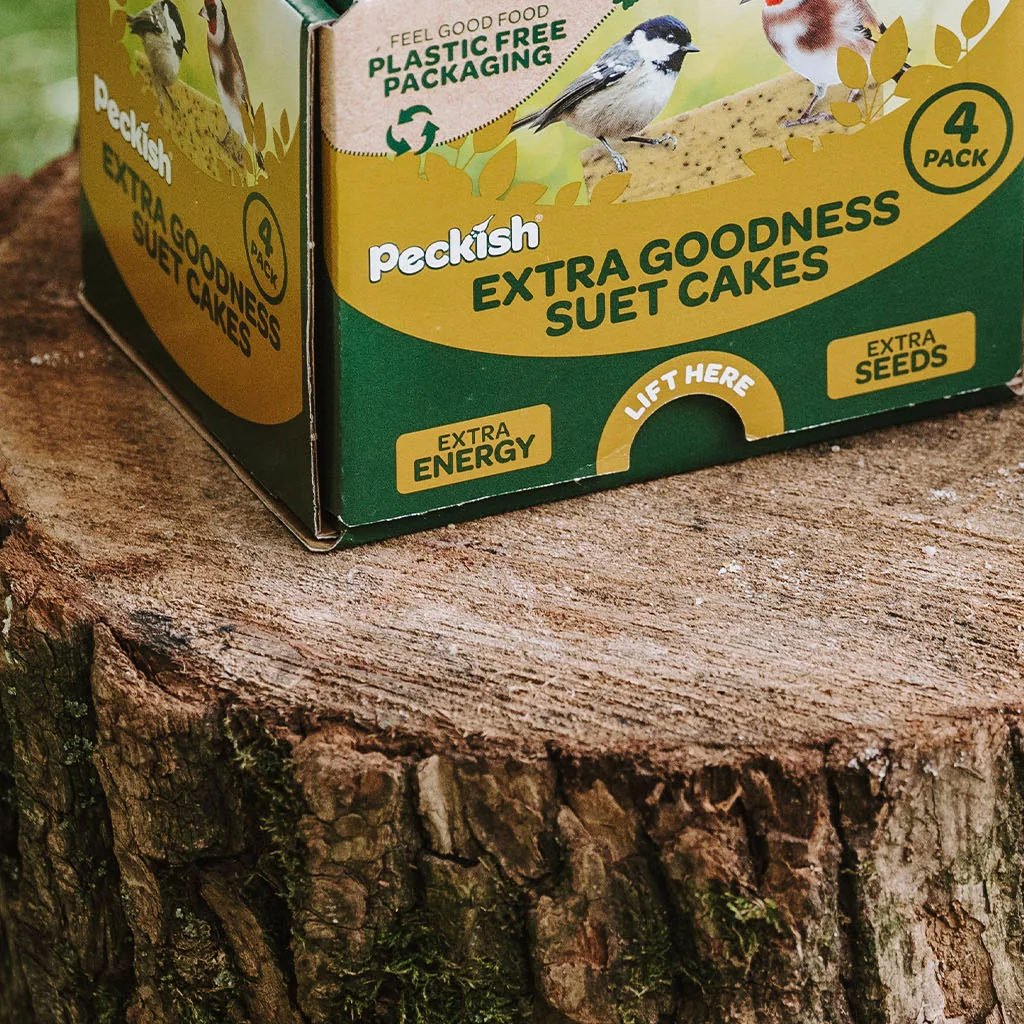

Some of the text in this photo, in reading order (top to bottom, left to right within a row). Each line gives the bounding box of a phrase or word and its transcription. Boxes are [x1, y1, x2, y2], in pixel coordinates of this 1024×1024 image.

[368, 19, 568, 78] PLASTIC FREE
[390, 4, 550, 49] FEEL GOOD FOOD
[383, 45, 553, 97] PACKAGING
[943, 101, 979, 144] 4
[923, 147, 990, 168] PACK
[102, 141, 281, 352] EXTRA GOODNESS
[258, 217, 274, 258] 4
[472, 190, 900, 312] EXTRA GOODNESS
[132, 210, 251, 359] SUET CAKES
[250, 239, 278, 290] PACK
[546, 245, 829, 337] SUET CAKES
[855, 344, 948, 385] SEEDS
[867, 329, 936, 357] EXTRA
[624, 363, 755, 420] LIFT HERE
[413, 434, 536, 481] ENERGY
[437, 421, 510, 453] EXTRA
